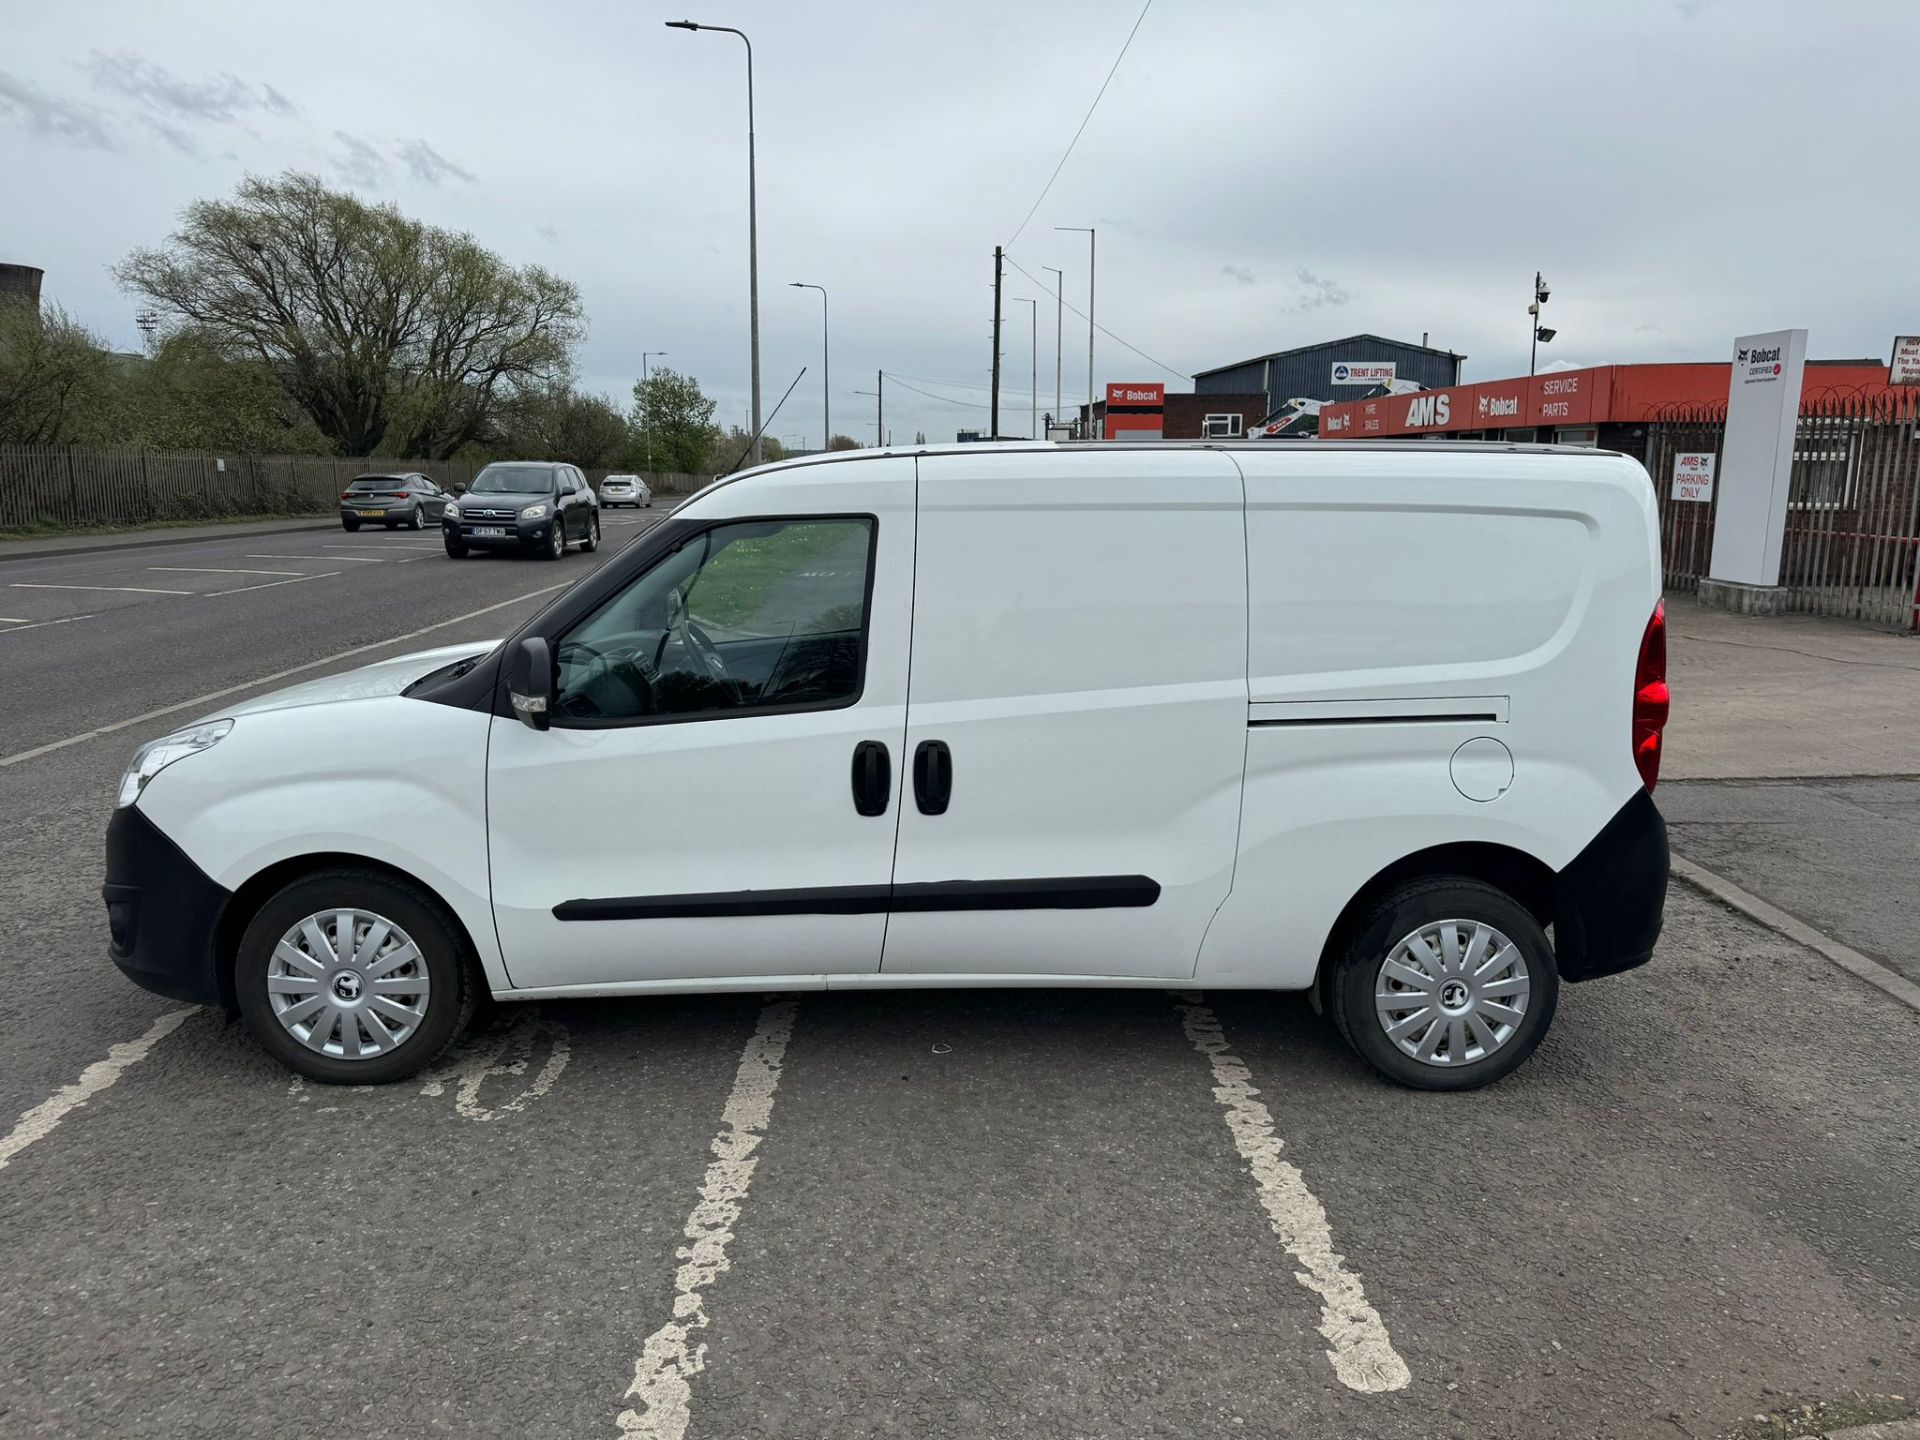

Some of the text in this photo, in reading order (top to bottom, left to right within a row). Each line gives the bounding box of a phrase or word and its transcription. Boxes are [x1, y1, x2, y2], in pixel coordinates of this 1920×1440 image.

[1751, 347, 1780, 364] Bobcat
[1901, 348, 1918, 356] Must
[1897, 357, 1910, 365] The
[1350, 368, 1393, 377] TRENT LIFTING
[1749, 366, 1772, 376] CERTIFIED
[1543, 378, 1578, 395] SERVICE
[1127, 390, 1157, 401] Bobcat
[1404, 394, 1450, 427] AMS
[1489, 396, 1518, 416] Bobcat
[1542, 402, 1568, 417] PARTS
[1364, 419, 1379, 431] SALES
[1680, 456, 1699, 467] AMS
[1676, 473, 1709, 485] PARKING
[1680, 486, 1700, 498] ONLY
